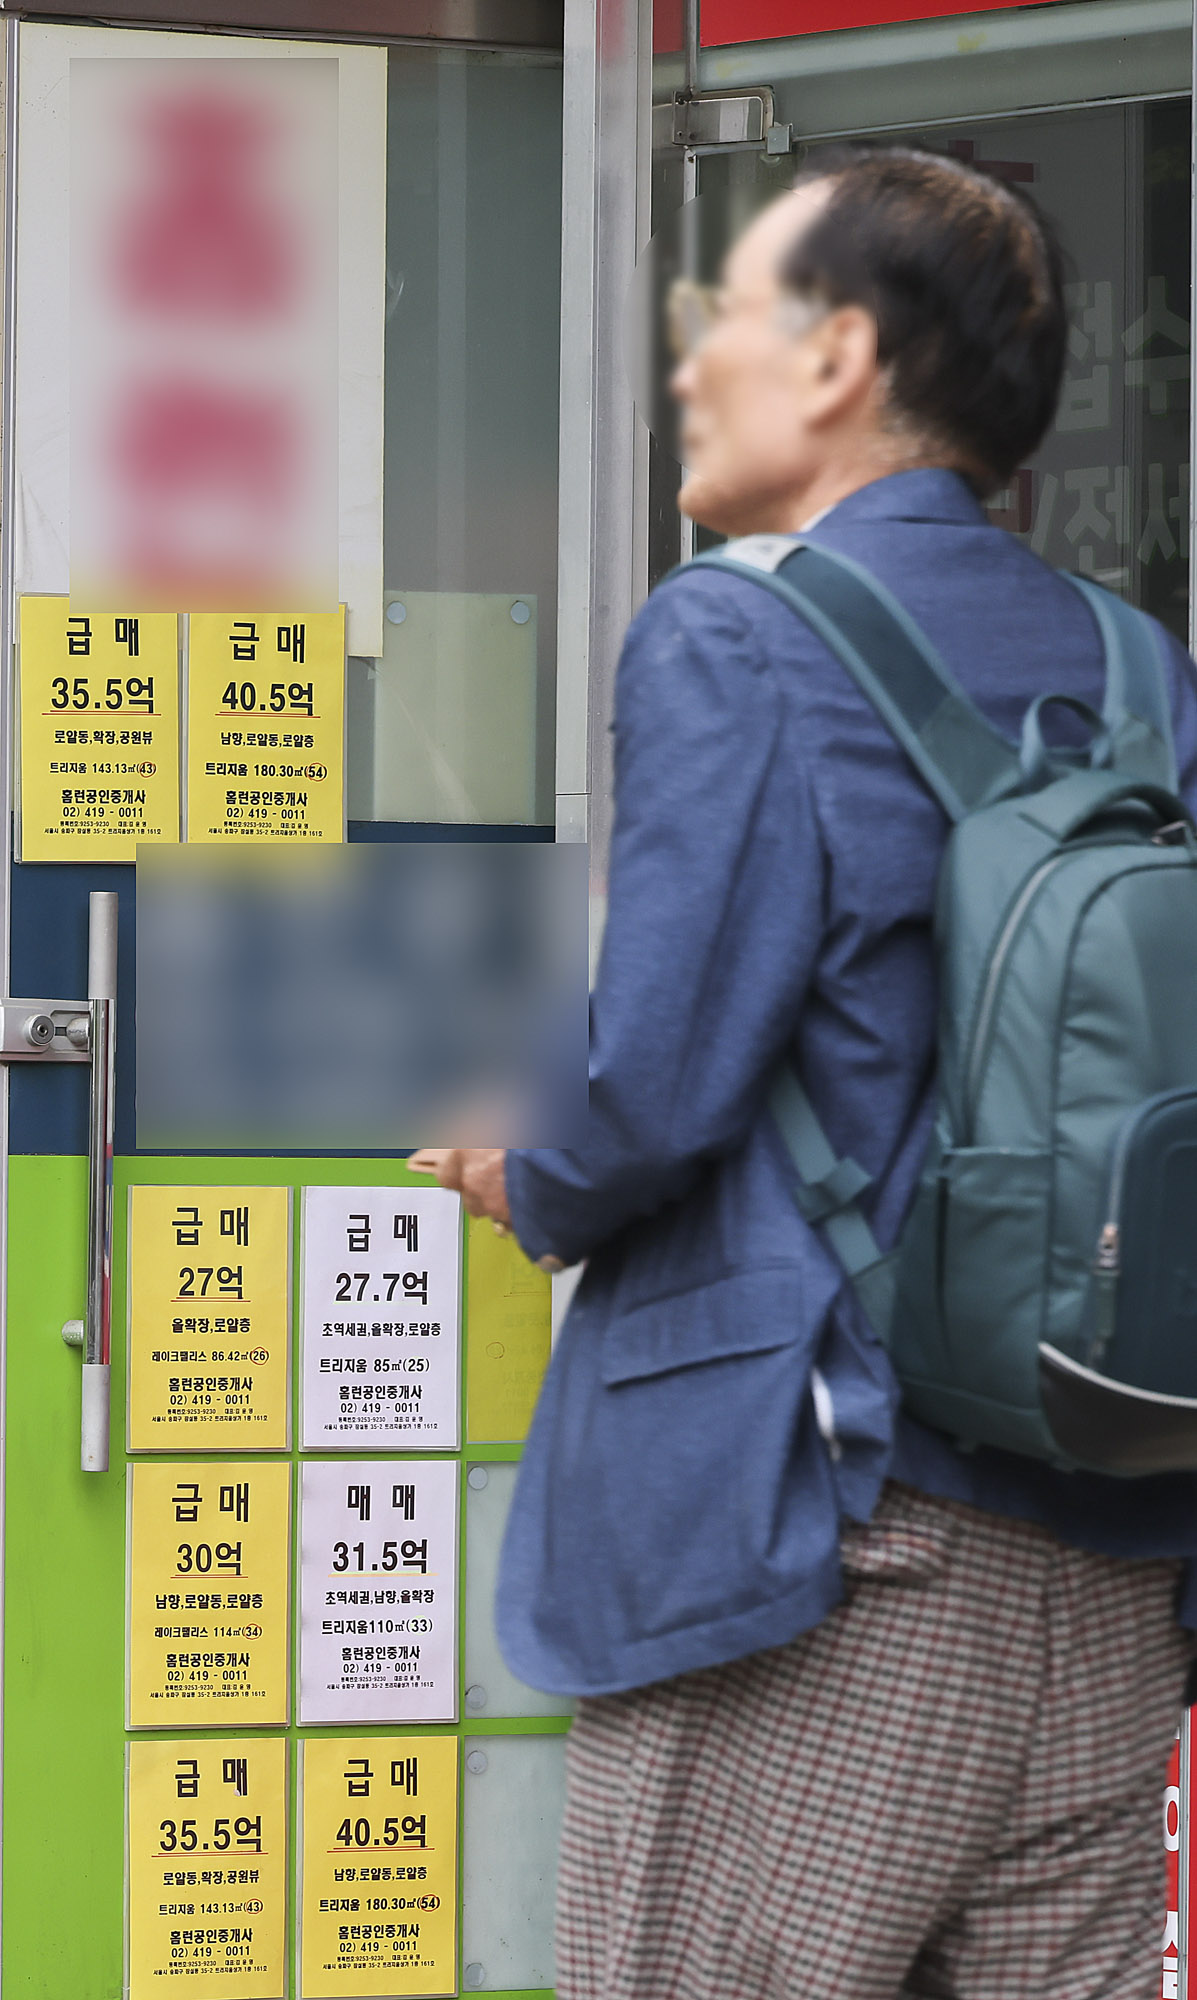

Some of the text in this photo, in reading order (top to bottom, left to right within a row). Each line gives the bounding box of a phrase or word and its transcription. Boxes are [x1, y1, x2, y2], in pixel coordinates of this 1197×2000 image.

[51, 677, 153, 713] 35.5억
[220, 682, 313, 716] 40.5억
[50, 763, 86, 773] 트리지움
[205, 763, 247, 776] 트리지움
[62, 790, 145, 804] 홈런공인중개사
[226, 791, 307, 806] 홈런공인중개사
[85, 807, 104, 817] 419
[119, 807, 142, 817] 0011
[249, 809, 267, 818] 419
[282, 809, 304, 819] 0011
[179, 1266, 243, 1299] 27억
[336, 1272, 428, 1305] 27.7억
[320, 1359, 367, 1372] 트리지움
[169, 1377, 253, 1391] 홈런공인중개사
[339, 1385, 422, 1399] 홈런공인중개사
[192, 1395, 211, 1404] 419
[226, 1395, 249, 1404] 0011
[362, 1403, 380, 1412] 419
[395, 1403, 418, 1412] 0011
[176, 1542, 241, 1576] 30억
[333, 1539, 427, 1573] 31.5억
[166, 1653, 250, 1667] 홈런공인중개사
[342, 1646, 420, 1661] 홈런공인중개사
[364, 1663, 381, 1672] 419
[395, 1662, 416, 1672] 0011
[189, 1671, 208, 1680] 419
[223, 1671, 246, 1680] 0011
[159, 1816, 263, 1852] 35.5억
[334, 1815, 427, 1849] 40.5억
[159, 1904, 194, 1915] 트리지움
[319, 1899, 360, 1911] 트리지움
[170, 1928, 252, 1945] 홈런공인중개사
[339, 1924, 419, 1939] 홈런공인중개사
[193, 1947, 211, 1957] 419
[226, 1946, 249, 1956] 0011
[361, 1942, 379, 1952] 419
[393, 1941, 416, 1951] 0011
